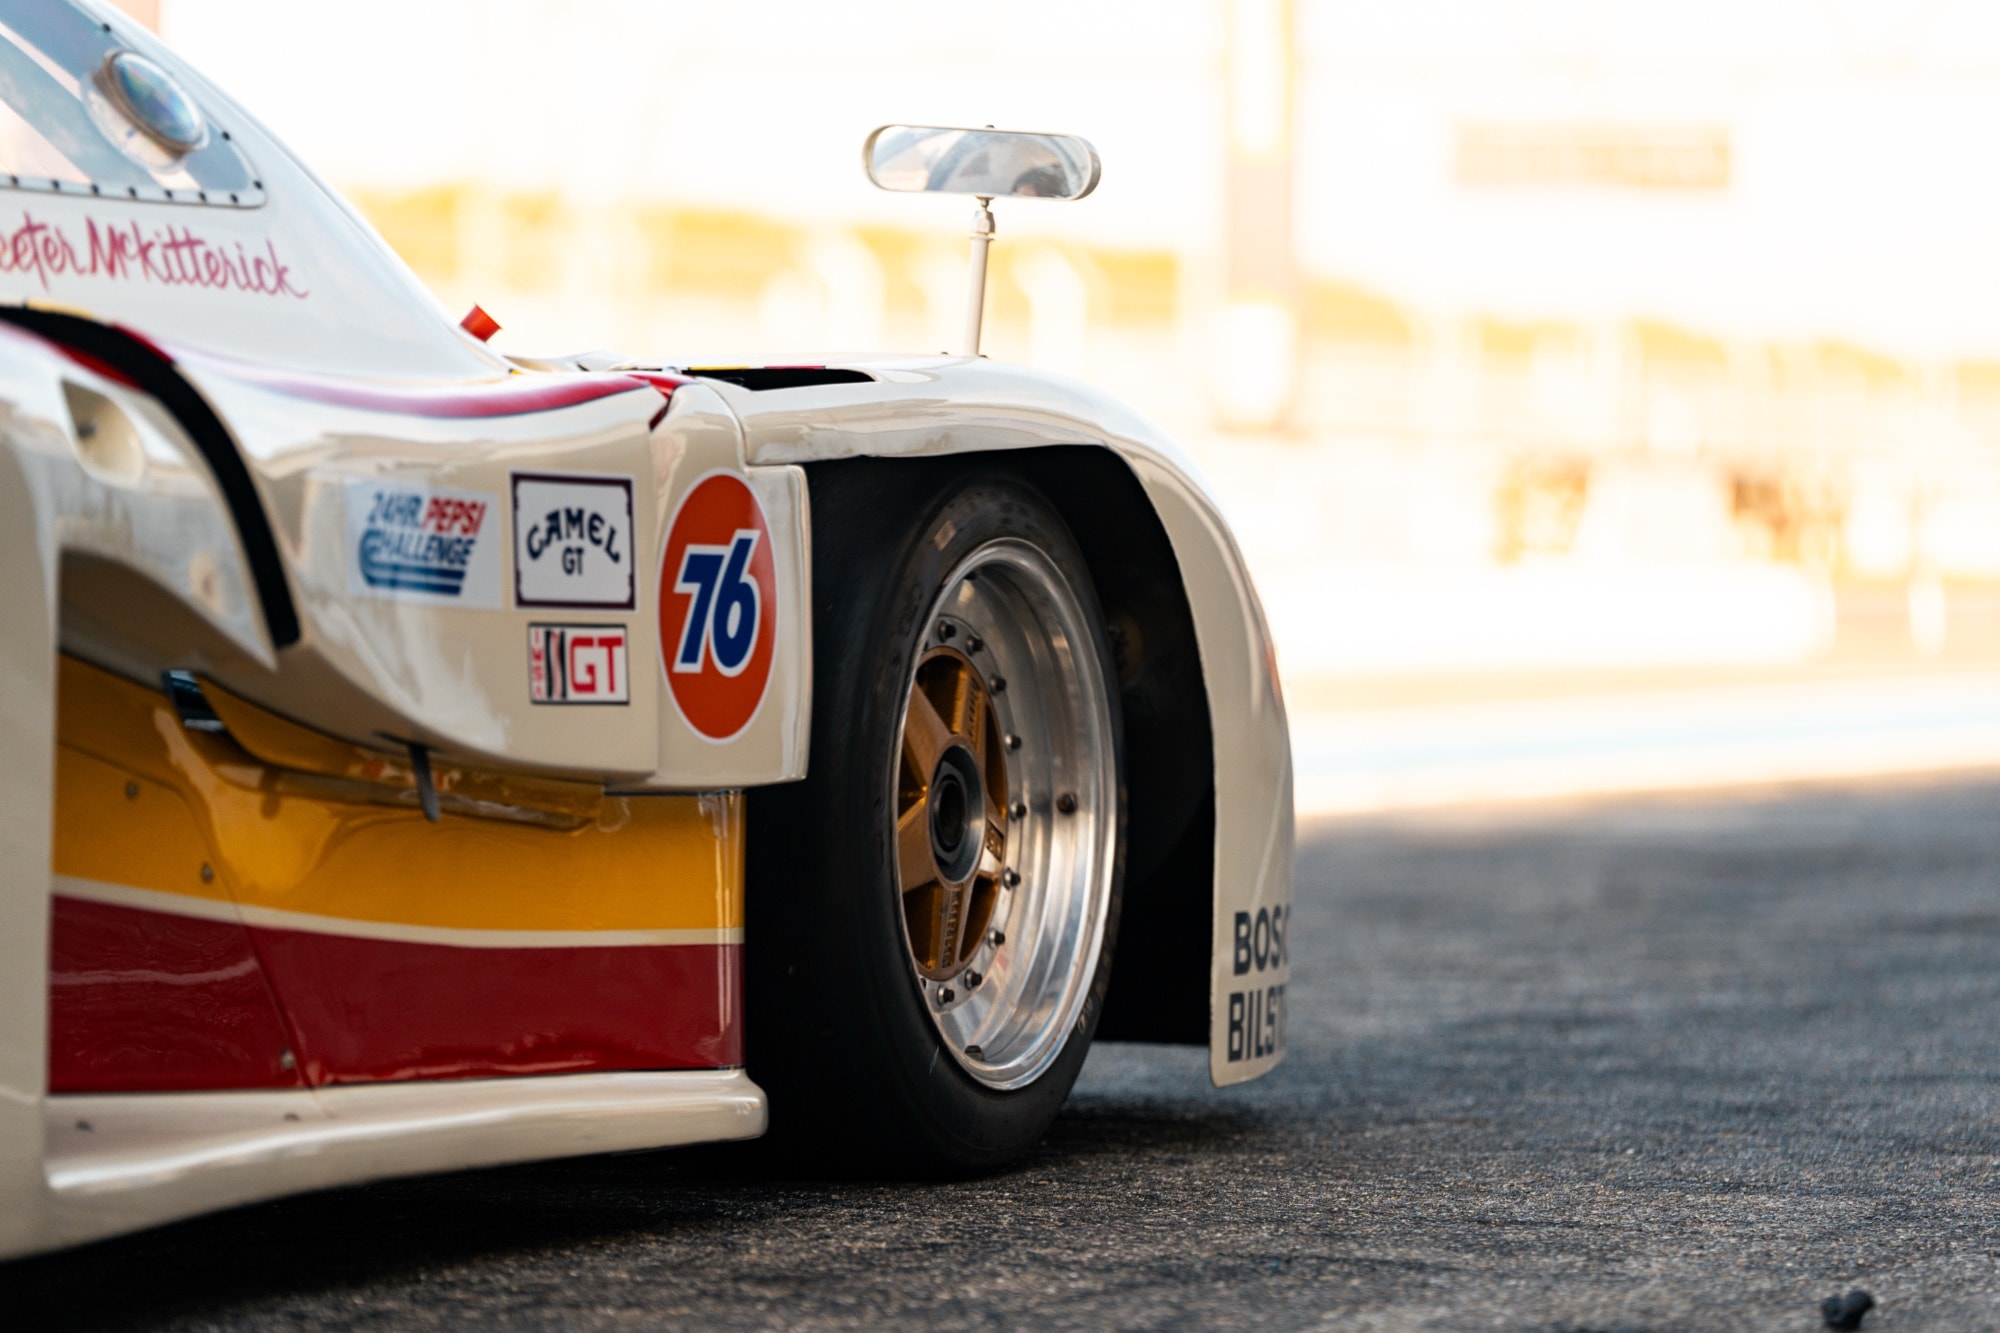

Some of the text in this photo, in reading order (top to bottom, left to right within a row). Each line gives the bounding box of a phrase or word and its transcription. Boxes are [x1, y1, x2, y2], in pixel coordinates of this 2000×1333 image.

[85, 214, 309, 298] McKitterick
[422, 496, 487, 534] PEPSI
[526, 507, 620, 564] CAMEL
[358, 528, 476, 586] CHALLENGE
[561, 546, 584, 576] GT
[673, 529, 761, 677] 76
[569, 635, 623, 694] GT
